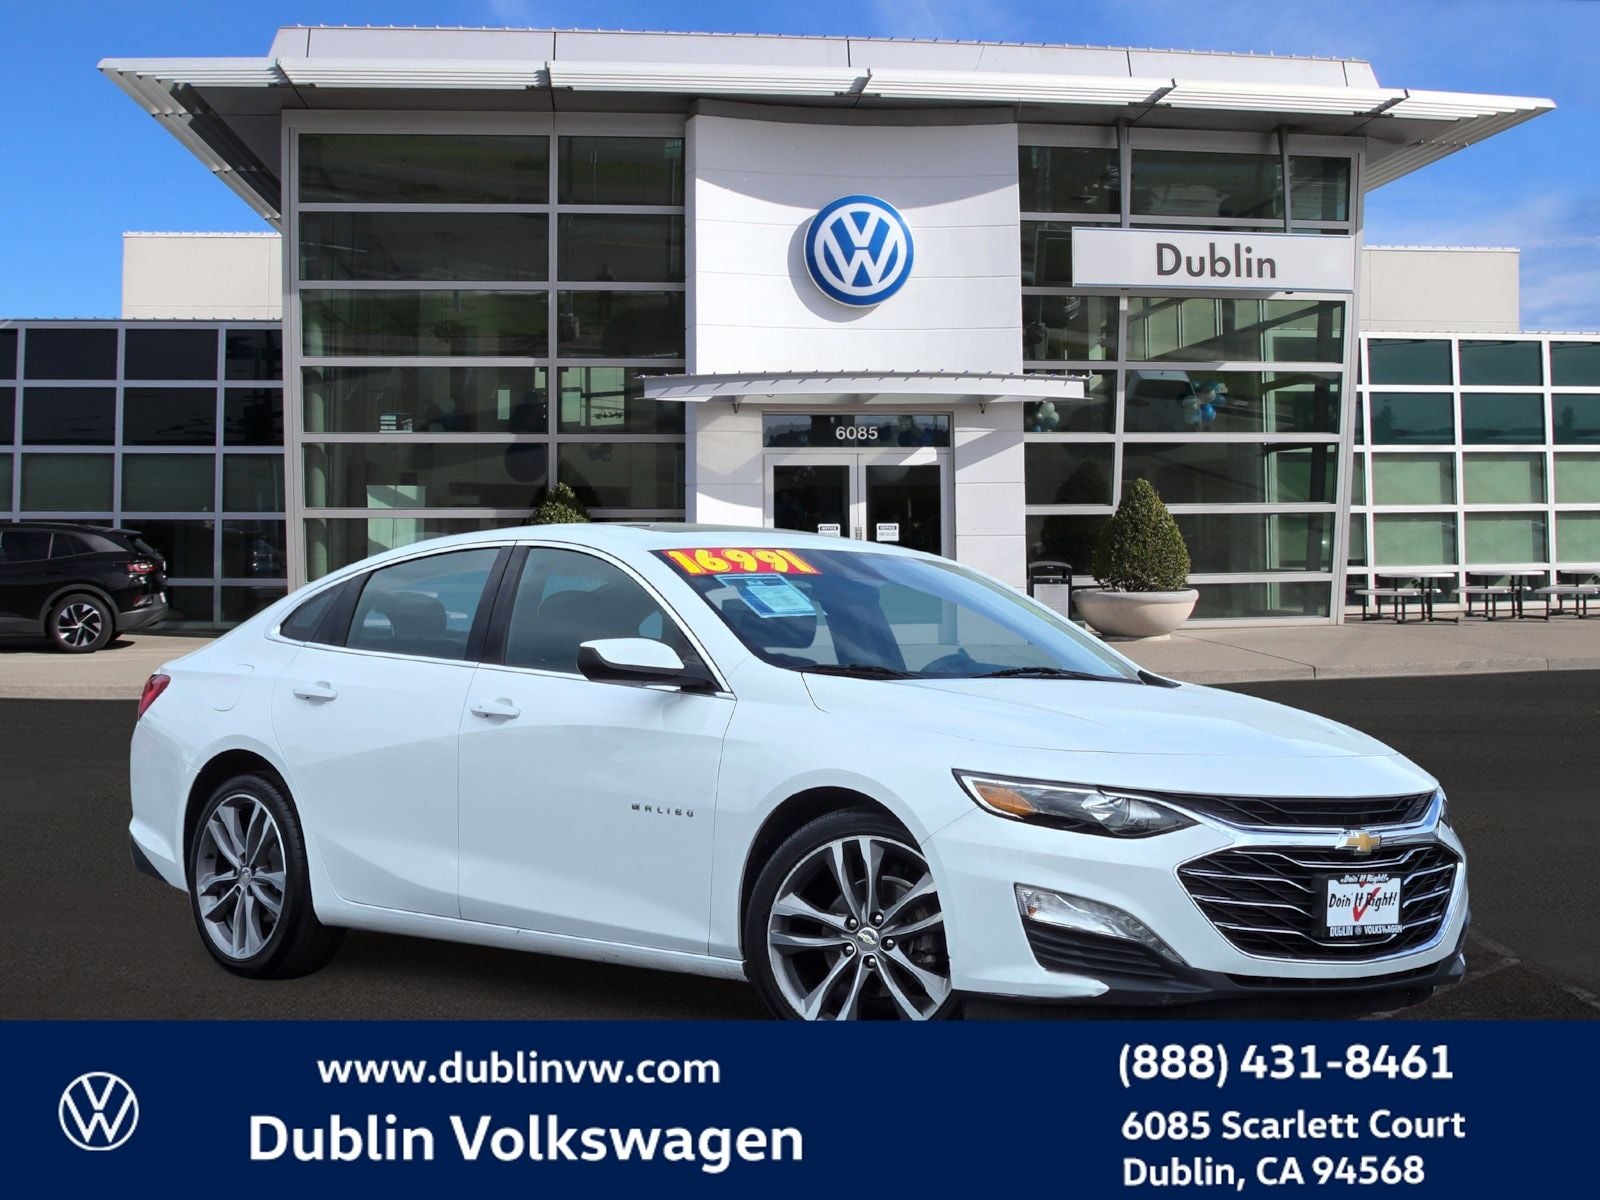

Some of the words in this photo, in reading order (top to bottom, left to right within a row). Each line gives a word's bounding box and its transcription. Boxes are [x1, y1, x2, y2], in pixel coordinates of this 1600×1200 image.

[1156, 242, 1277, 279] Dublin
[835, 426, 878, 440] 6085
[667, 549, 818, 574] 16991
[631, 803, 694, 818] MALIBU
[1354, 892, 1363, 907] It
[1366, 892, 1397, 911] Right!
[1330, 926, 1353, 937] DUBLIN
[1364, 924, 1402, 935] VOLKSWAGEN
